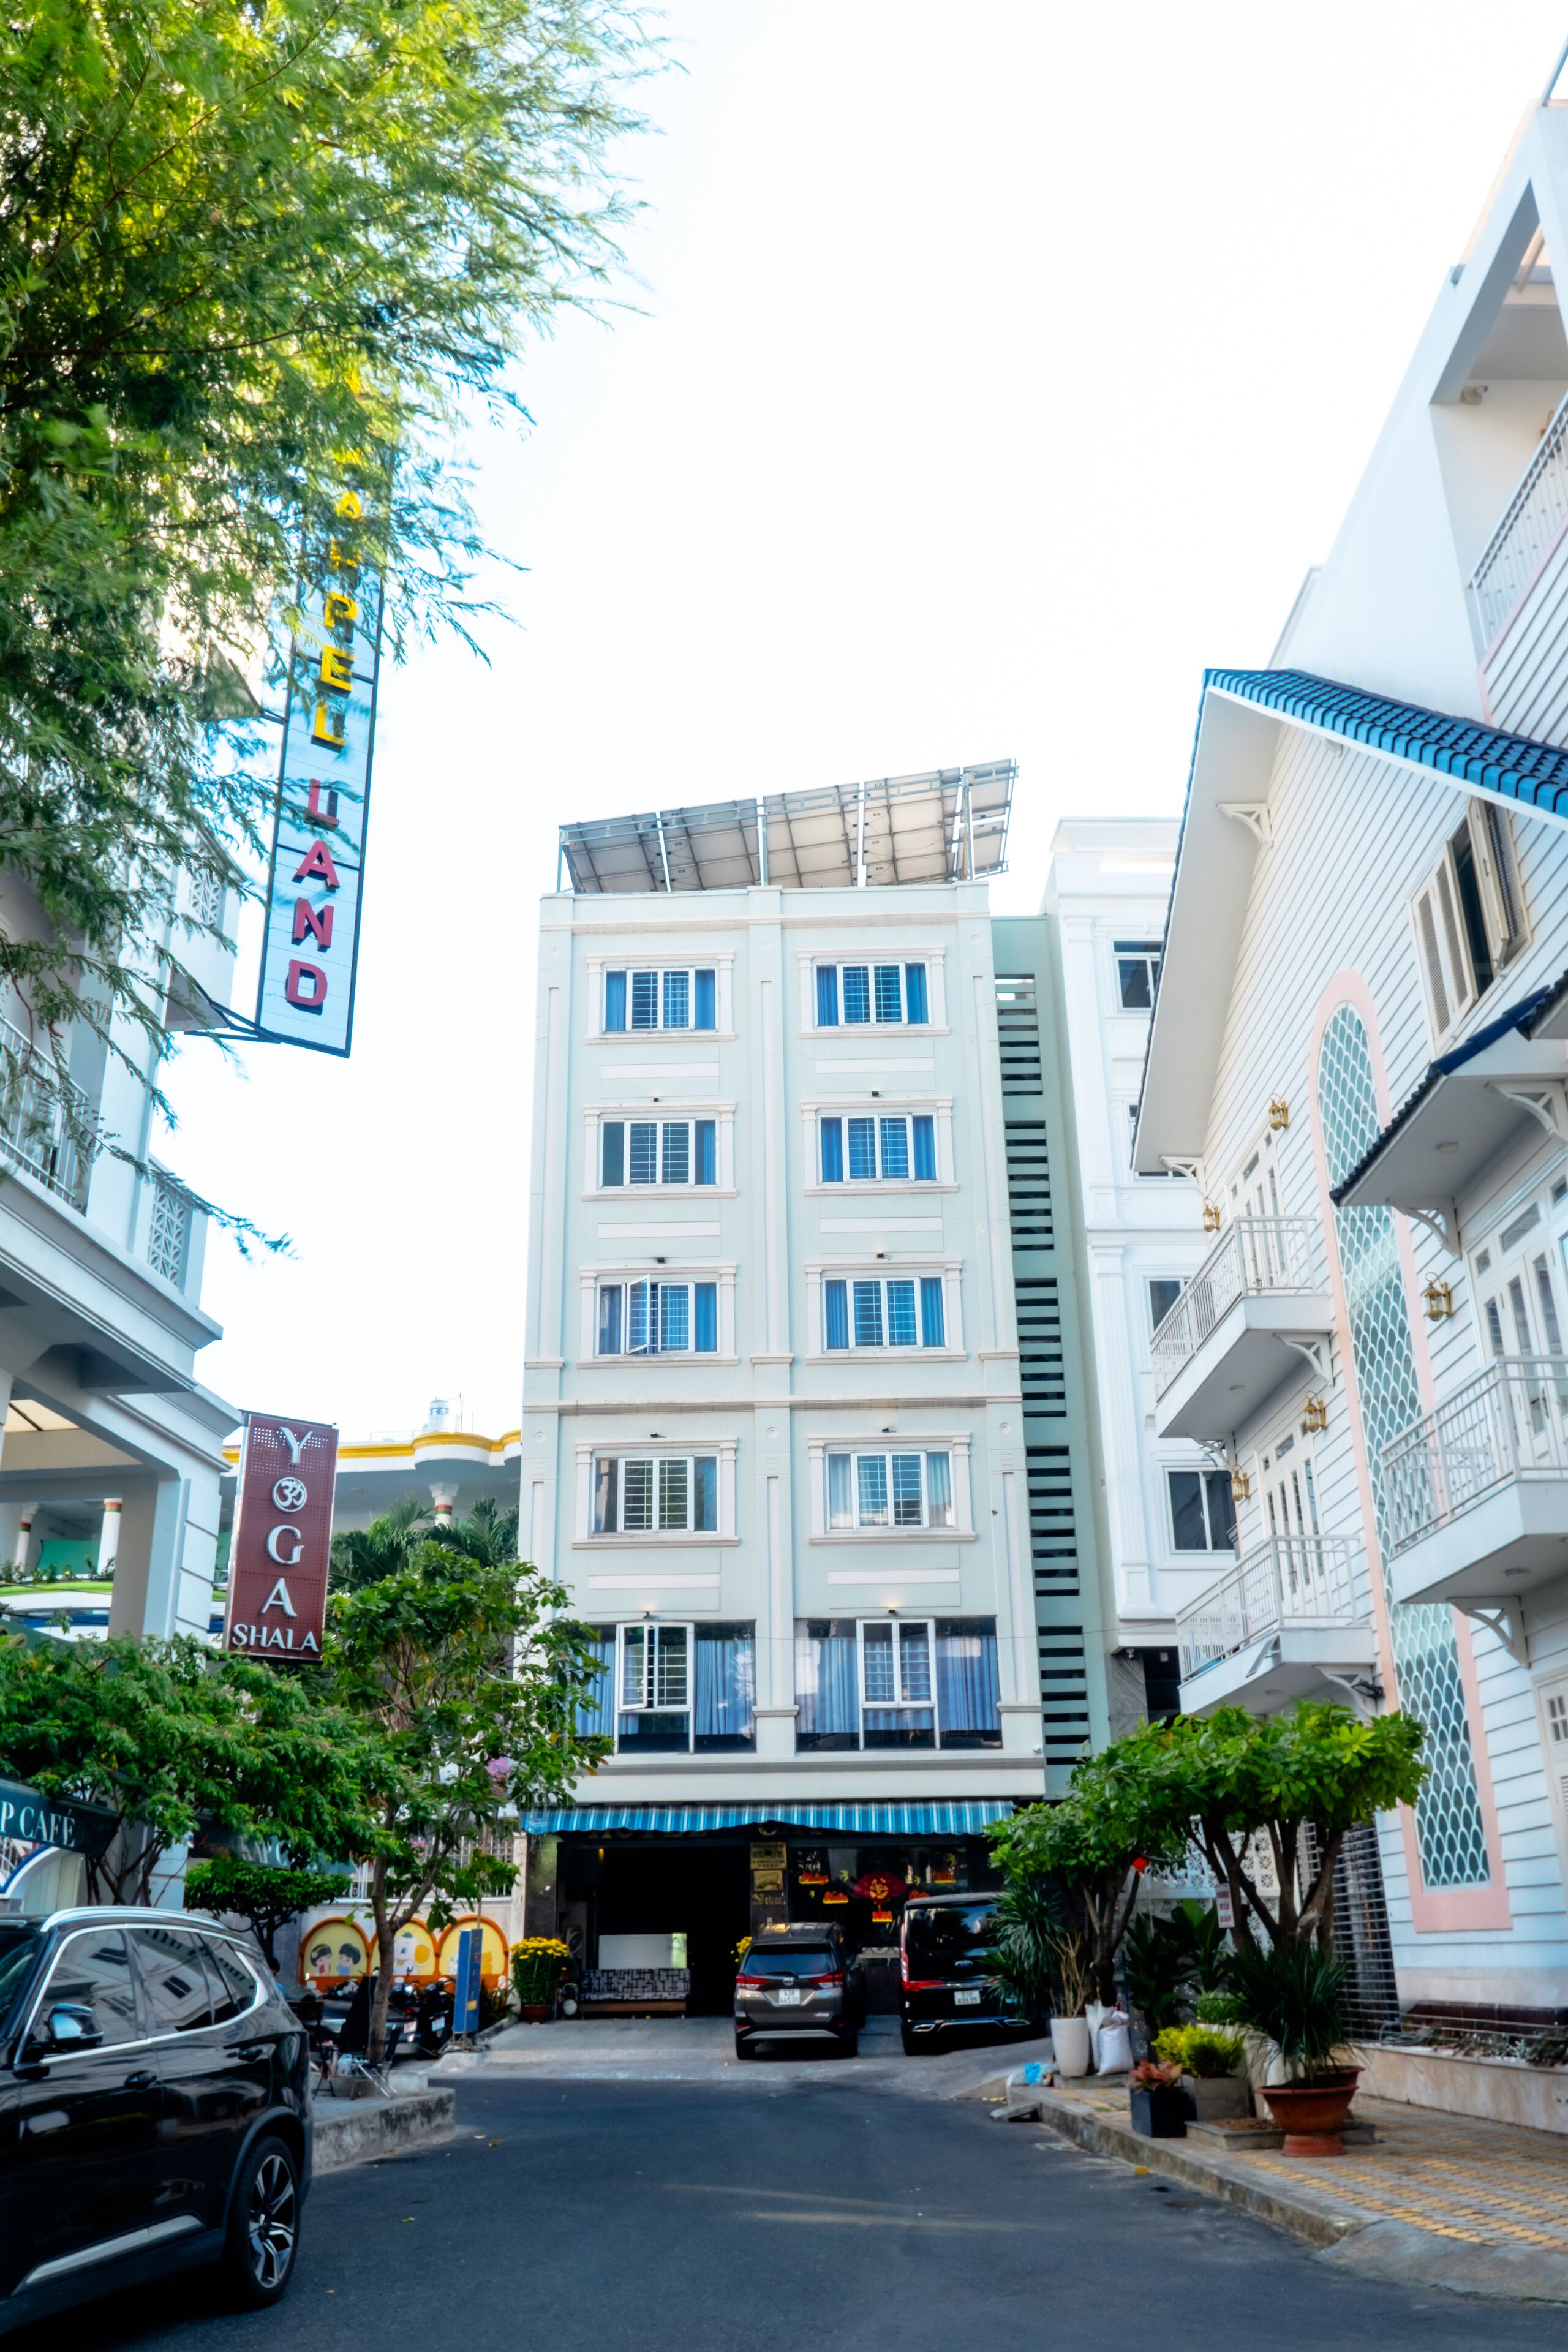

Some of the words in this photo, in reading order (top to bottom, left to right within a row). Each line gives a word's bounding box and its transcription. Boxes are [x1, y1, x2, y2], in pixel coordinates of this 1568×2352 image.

[286, 777, 341, 1011] LAND
[231, 1623, 320, 1653] SHALA
[20, 1806, 75, 1847] CAFÉ
